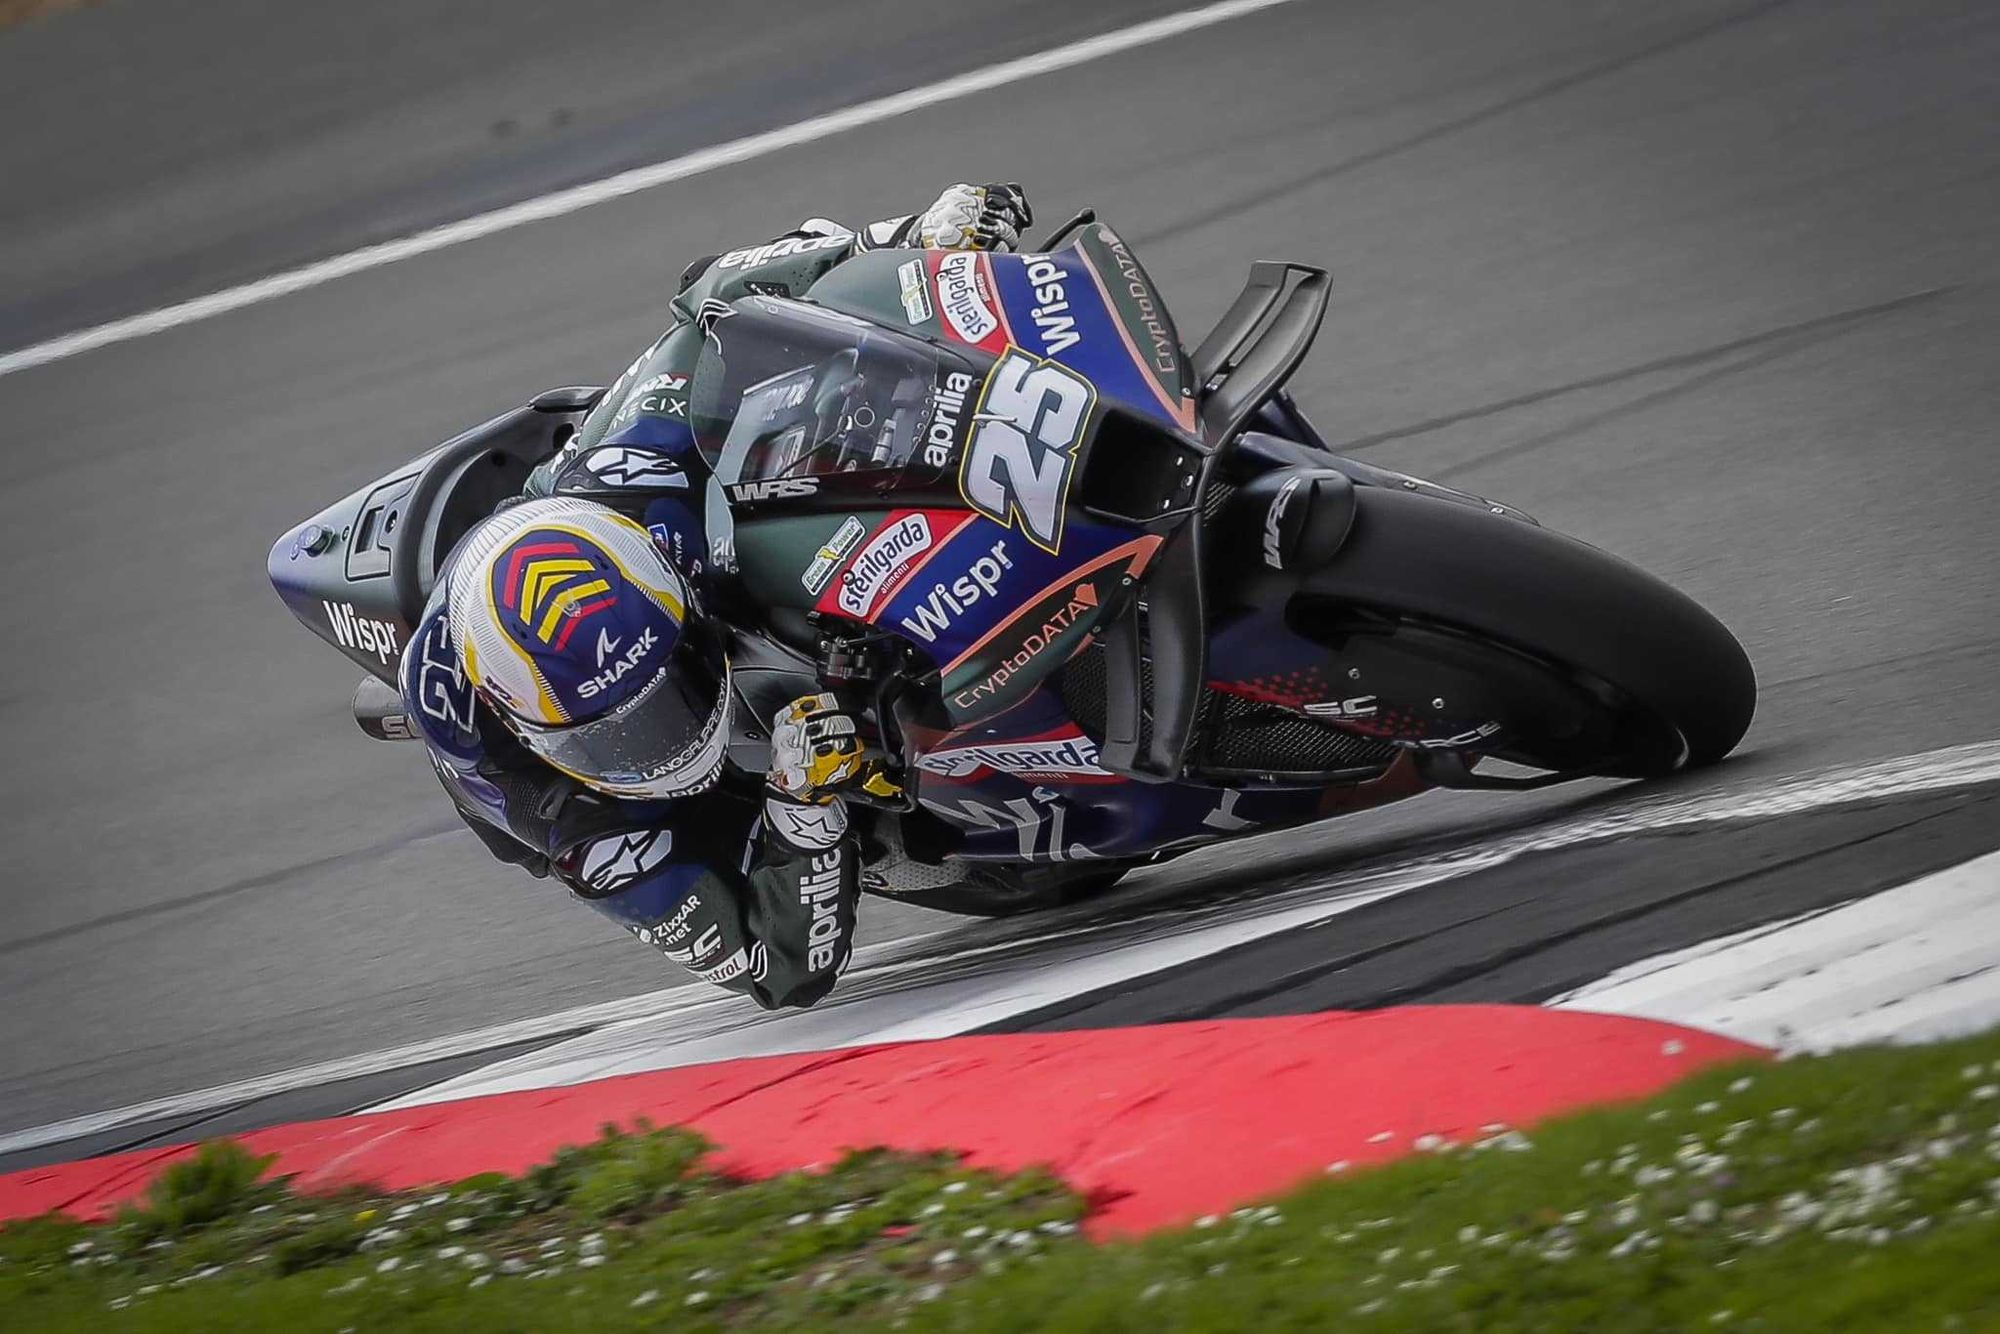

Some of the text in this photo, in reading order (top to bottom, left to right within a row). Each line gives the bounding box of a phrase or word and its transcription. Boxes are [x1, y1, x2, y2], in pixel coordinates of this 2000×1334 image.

[718, 234, 855, 271] aprilia
[1021, 254, 1080, 354] Wispr
[1112, 243, 1176, 372] CryptoDATA
[924, 372, 972, 468] aprilia
[963, 346, 1090, 545] 25
[732, 477, 820, 501] WRS
[845, 521, 925, 610] sterilgarda
[880, 562, 911, 594] alimenti
[902, 540, 1013, 643] Wispr
[323, 600, 399, 665] Wispr
[577, 627, 659, 698] SHARK
[955, 597, 1089, 708] CryptoDATA
[665, 922, 692, 946] .net
[800, 848, 841, 972] aprilia
[706, 957, 742, 982] strol
